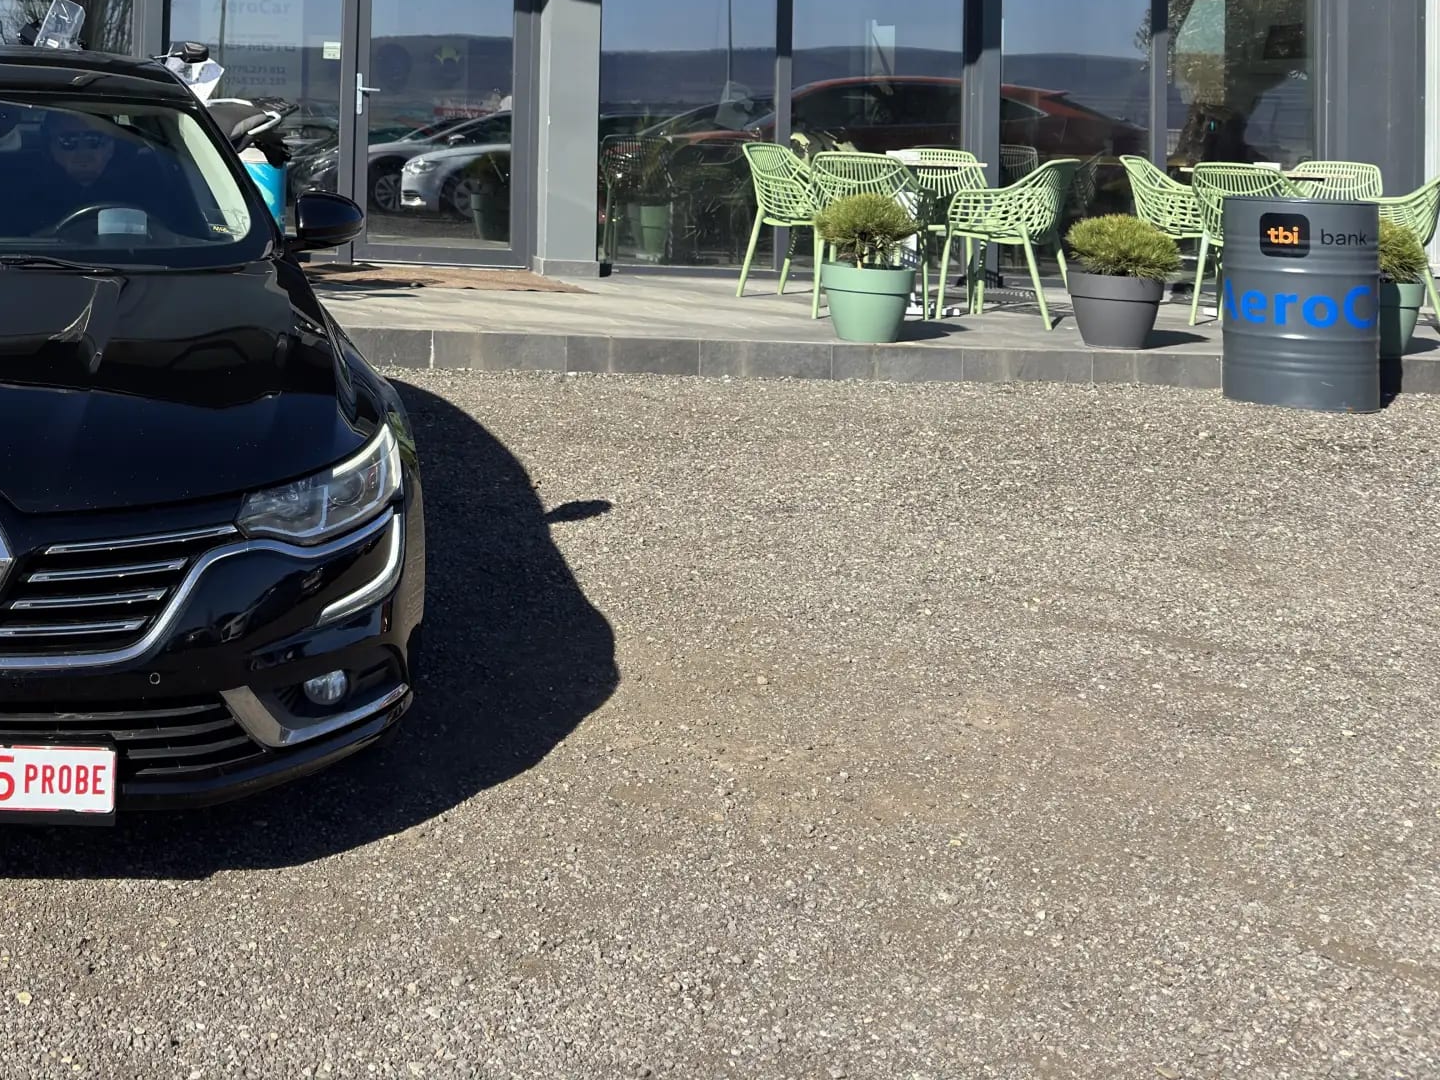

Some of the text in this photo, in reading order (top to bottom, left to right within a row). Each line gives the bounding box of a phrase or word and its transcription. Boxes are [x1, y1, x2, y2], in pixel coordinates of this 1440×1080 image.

[1266, 225, 1368, 246] tbi bank
[1224, 276, 1377, 330] AeroC
[23, 763, 106, 796] PROBE
